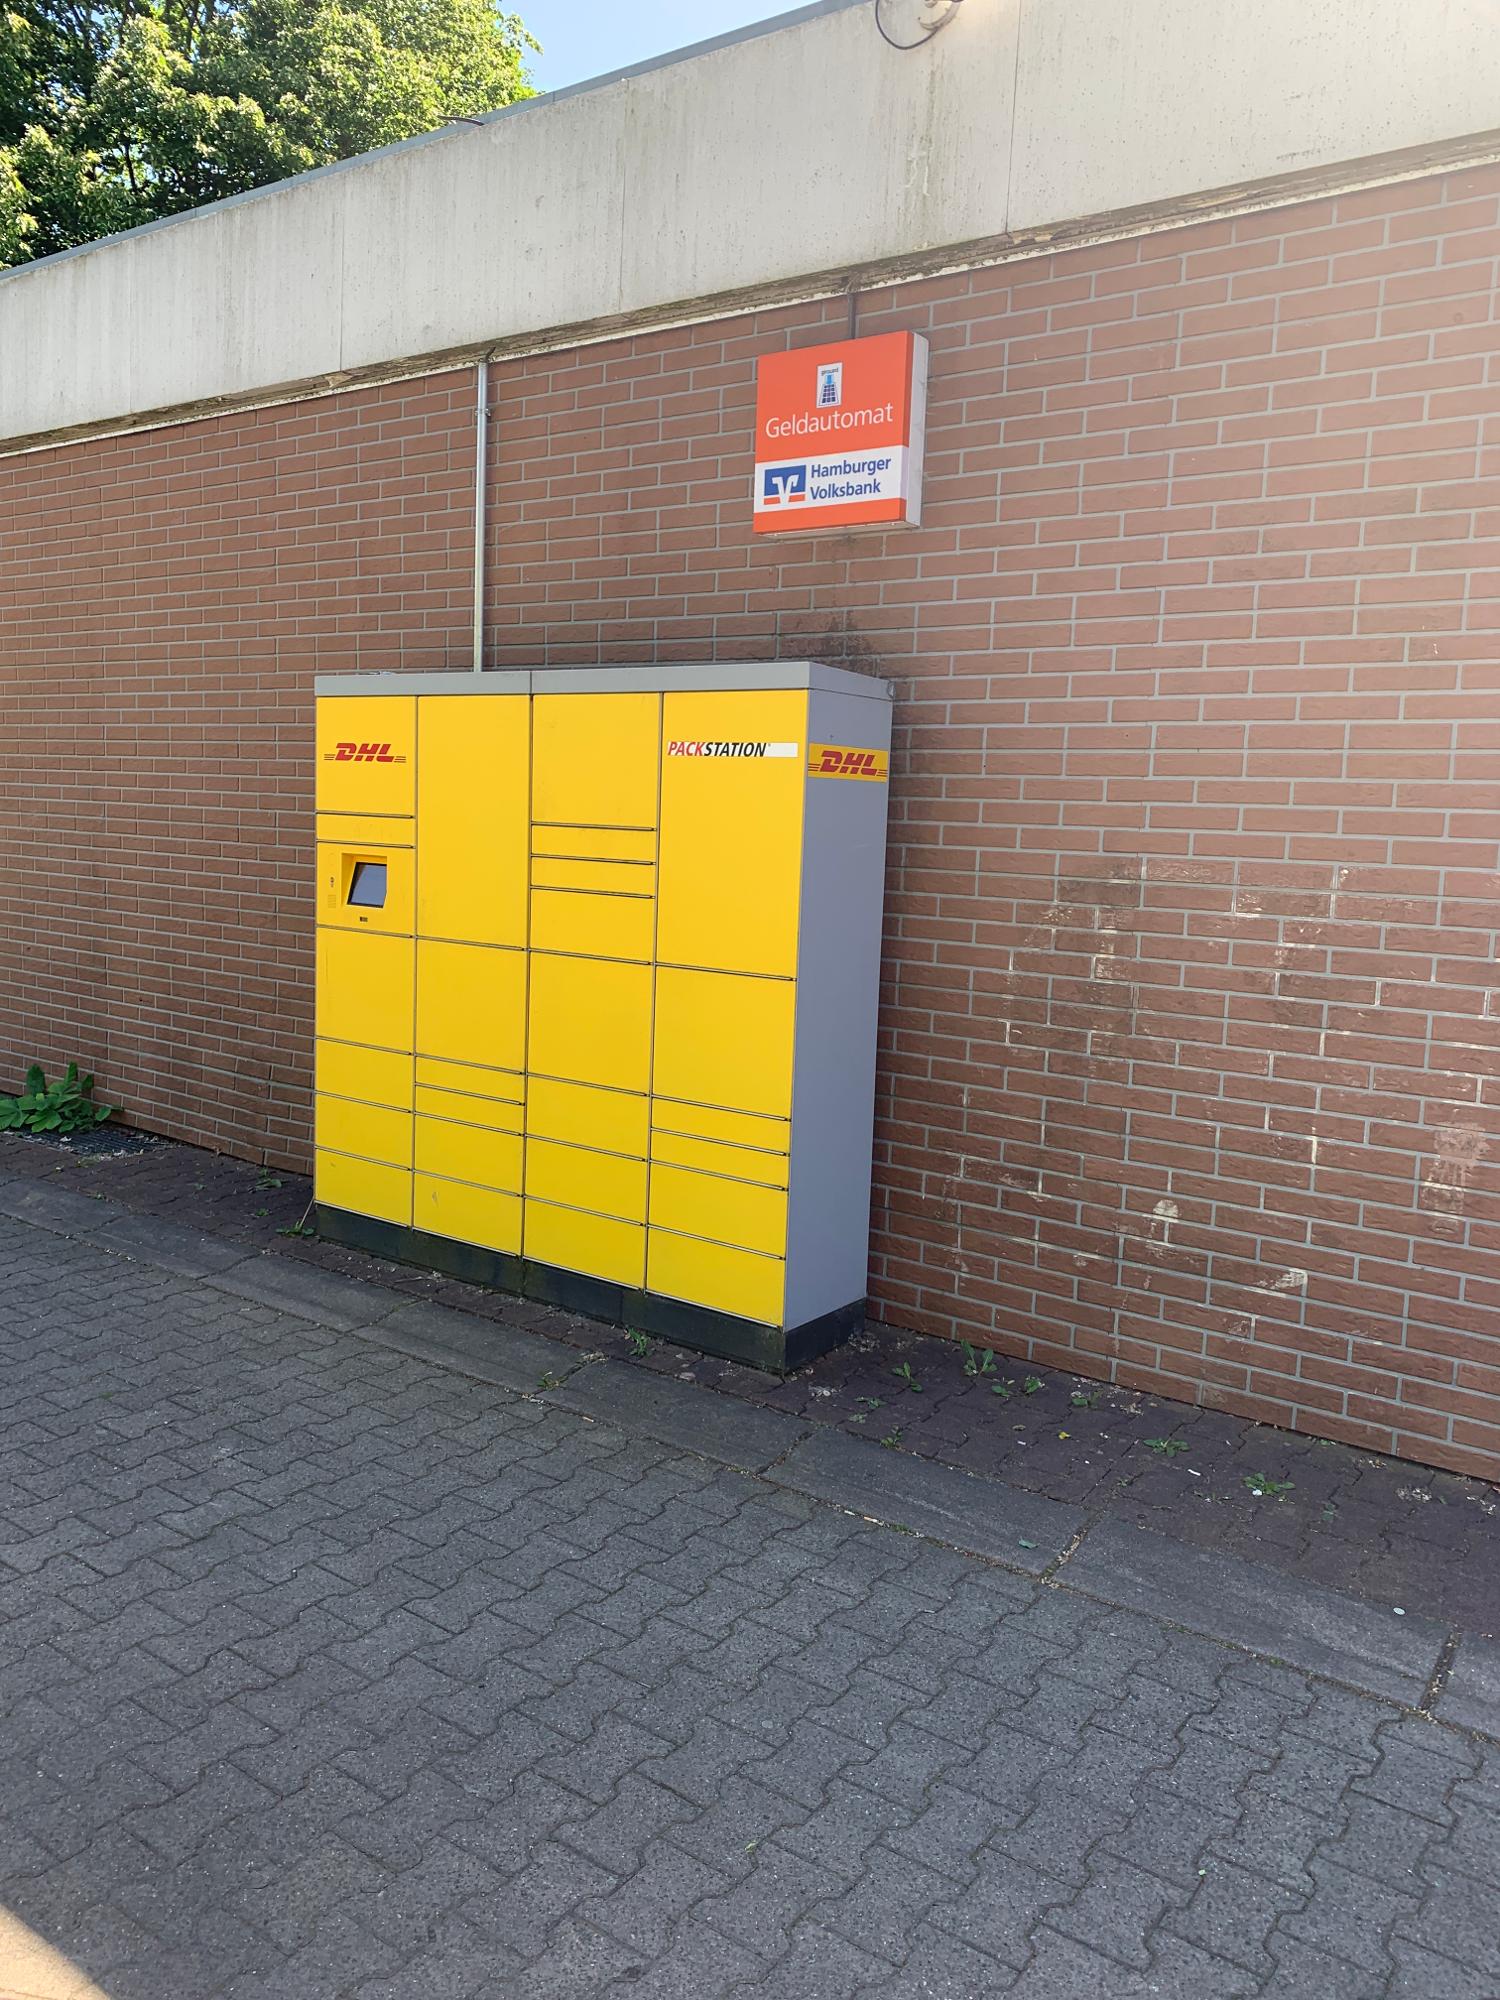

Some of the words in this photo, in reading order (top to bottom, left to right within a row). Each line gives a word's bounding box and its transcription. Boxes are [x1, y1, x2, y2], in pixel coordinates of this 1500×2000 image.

[765, 402, 893, 438] Geldautomat
[811, 457, 891, 478] Hamburger
[810, 479, 880, 500] Volksbank
[335, 742, 394, 762] DHL
[820, 750, 878, 776] DHL
